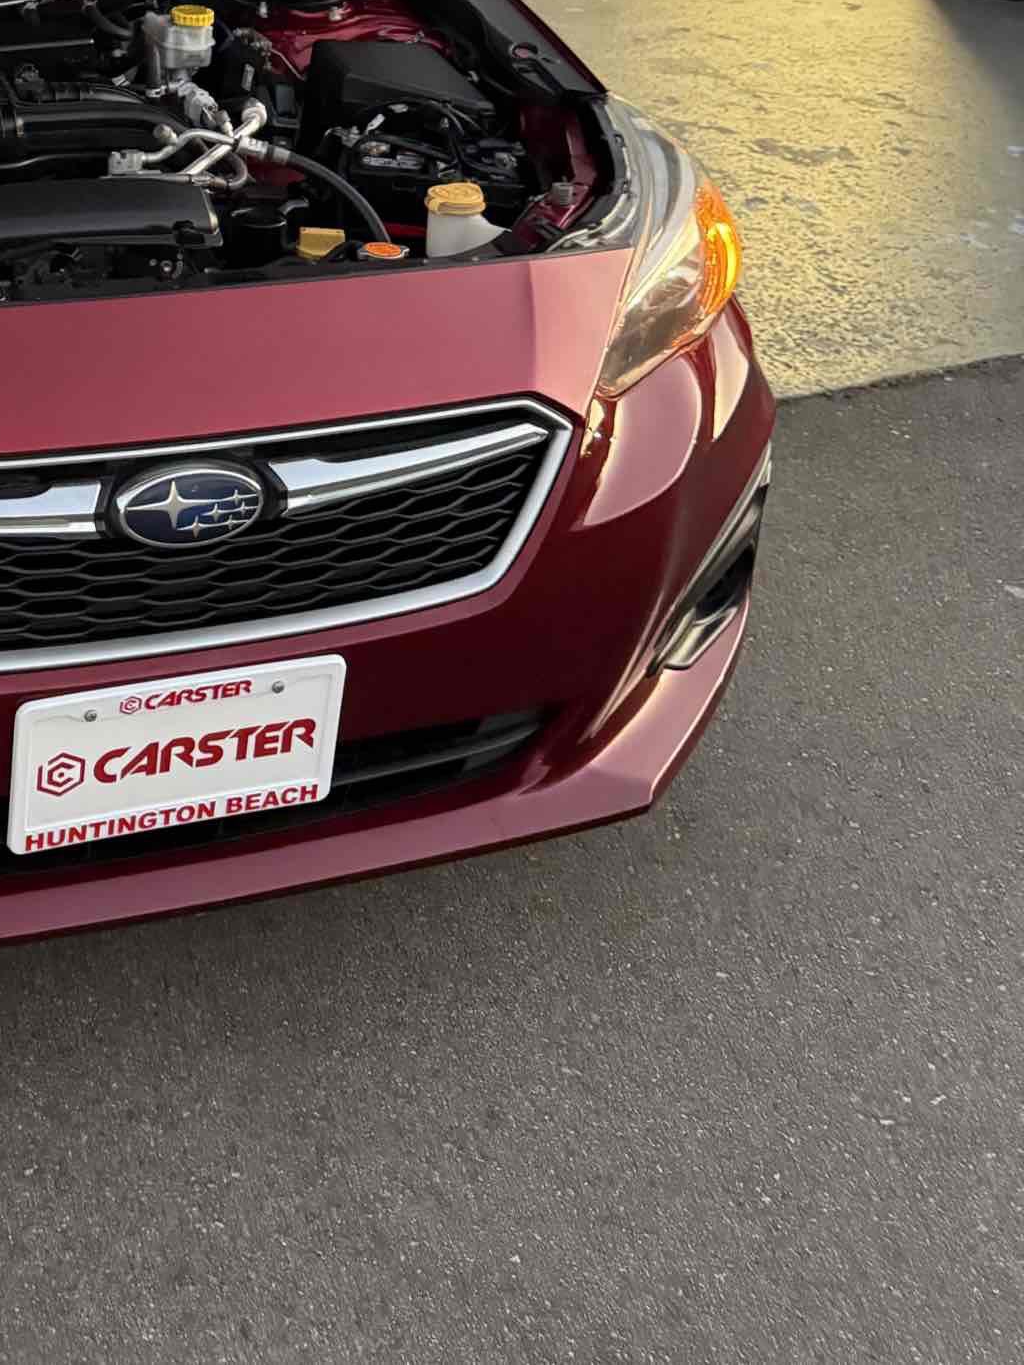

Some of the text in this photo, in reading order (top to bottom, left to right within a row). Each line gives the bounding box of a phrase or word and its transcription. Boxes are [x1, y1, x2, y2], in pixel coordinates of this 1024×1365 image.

[144, 680, 252, 710] CARSTER
[93, 718, 317, 784] CARSTER
[26, 784, 318, 851] HUNTINGTON BEACH
